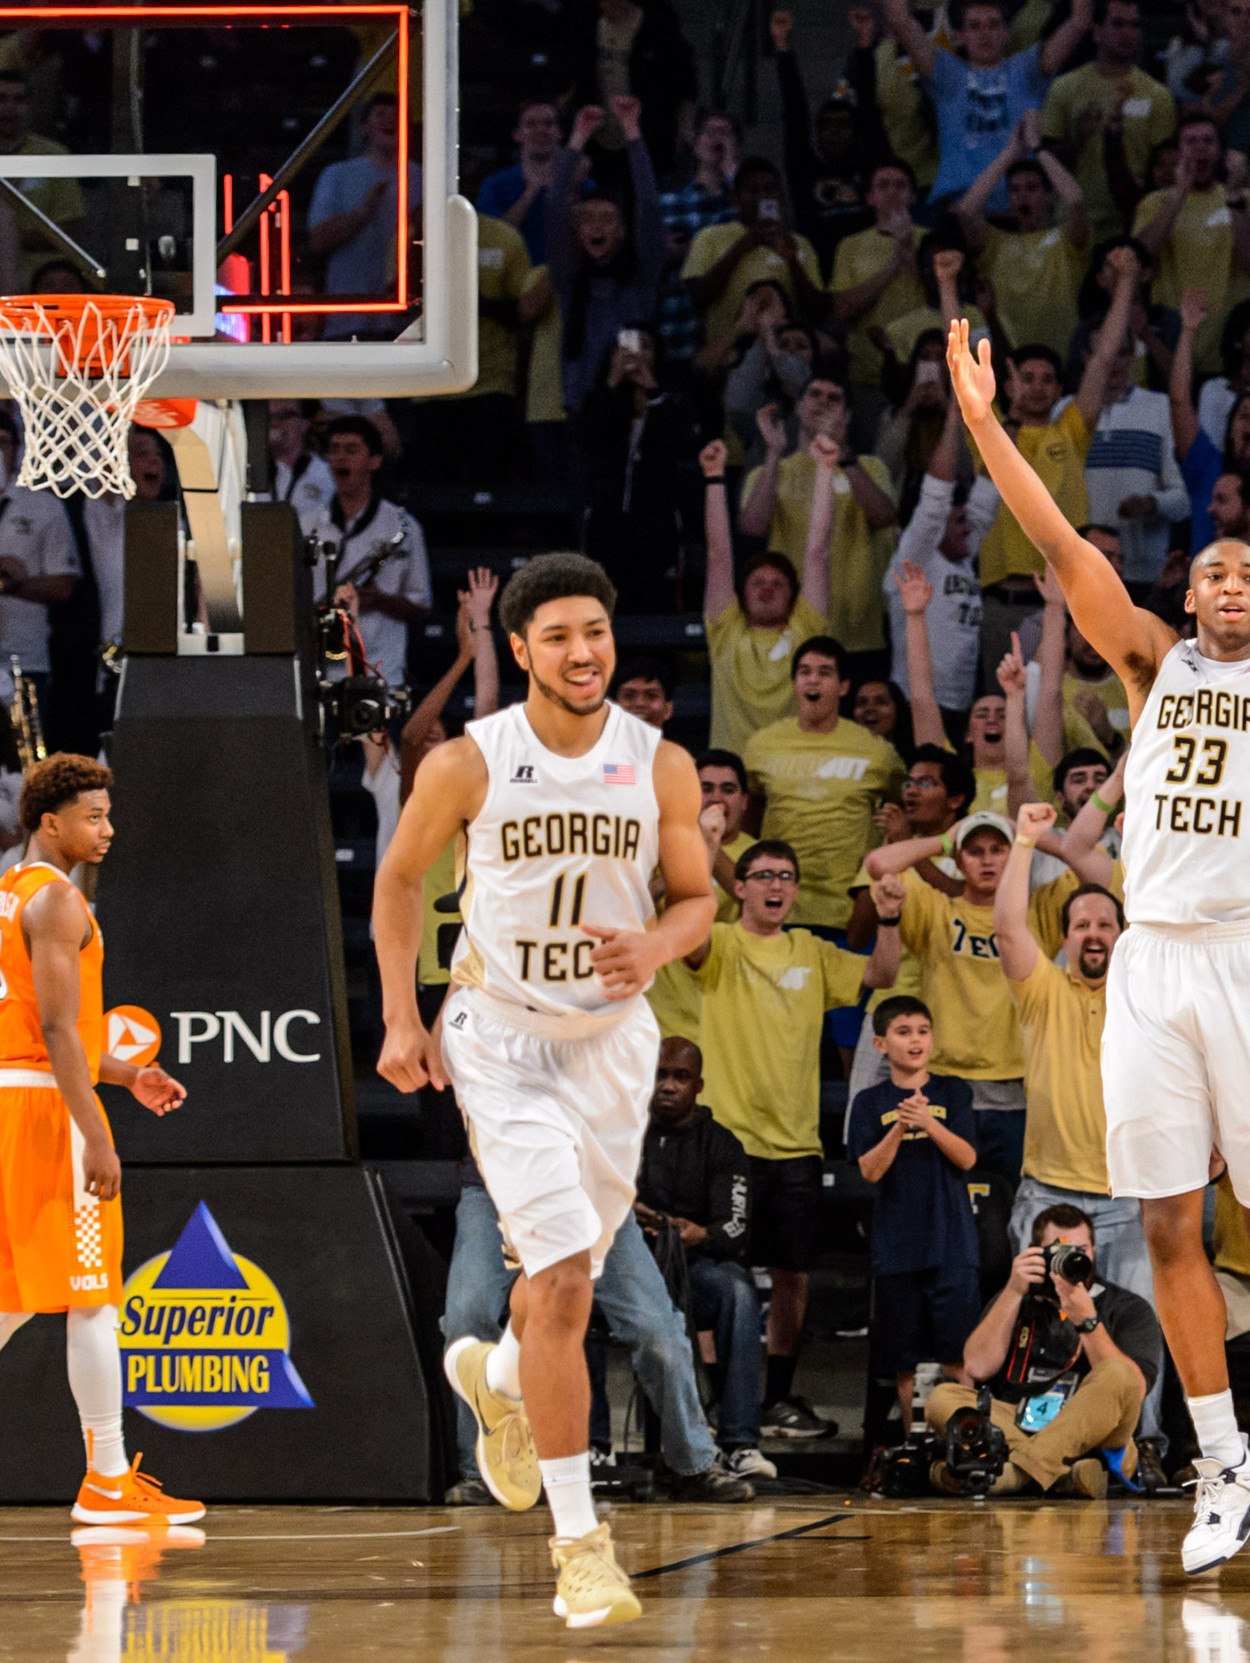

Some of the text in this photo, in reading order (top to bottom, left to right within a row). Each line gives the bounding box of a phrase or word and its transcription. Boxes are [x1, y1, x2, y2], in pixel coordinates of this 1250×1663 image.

[1166, 734, 1229, 787] 33
[501, 812, 640, 863] GEORGIA
[1154, 794, 1242, 837] TECH
[549, 872, 588, 929] 11
[515, 939, 602, 981] TEC
[169, 1009, 322, 1065] PNC
[69, 1272, 109, 1291] VOLS
[121, 1295, 275, 1345] Superior
[127, 1354, 271, 1393] PLUMBING
